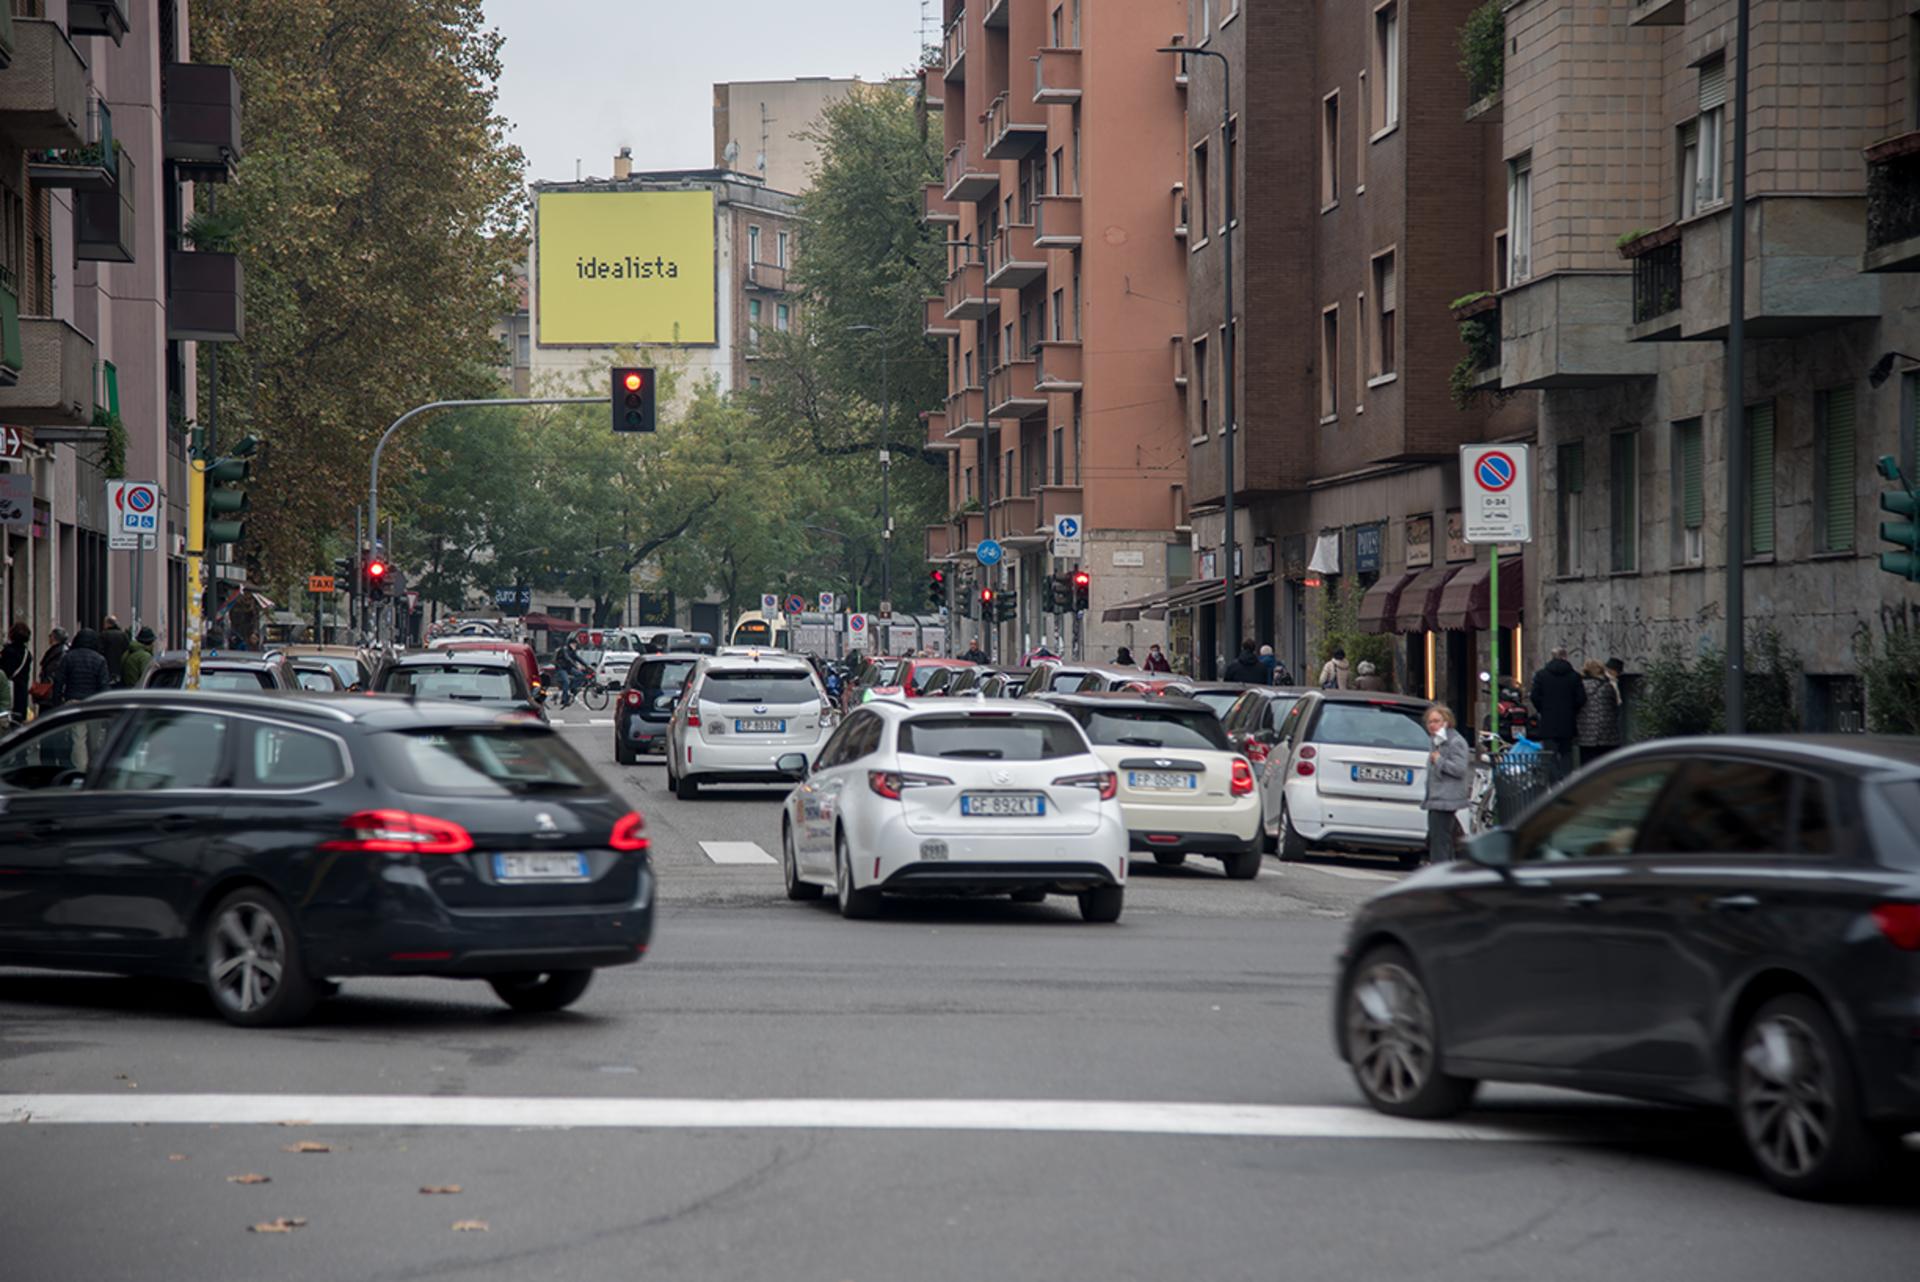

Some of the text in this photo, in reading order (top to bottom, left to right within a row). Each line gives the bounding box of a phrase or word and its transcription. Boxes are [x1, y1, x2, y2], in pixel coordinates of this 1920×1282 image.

[576, 256, 677, 279] idealista
[310, 578, 333, 588] TAXI
[971, 798, 1035, 812] GF 892KT
